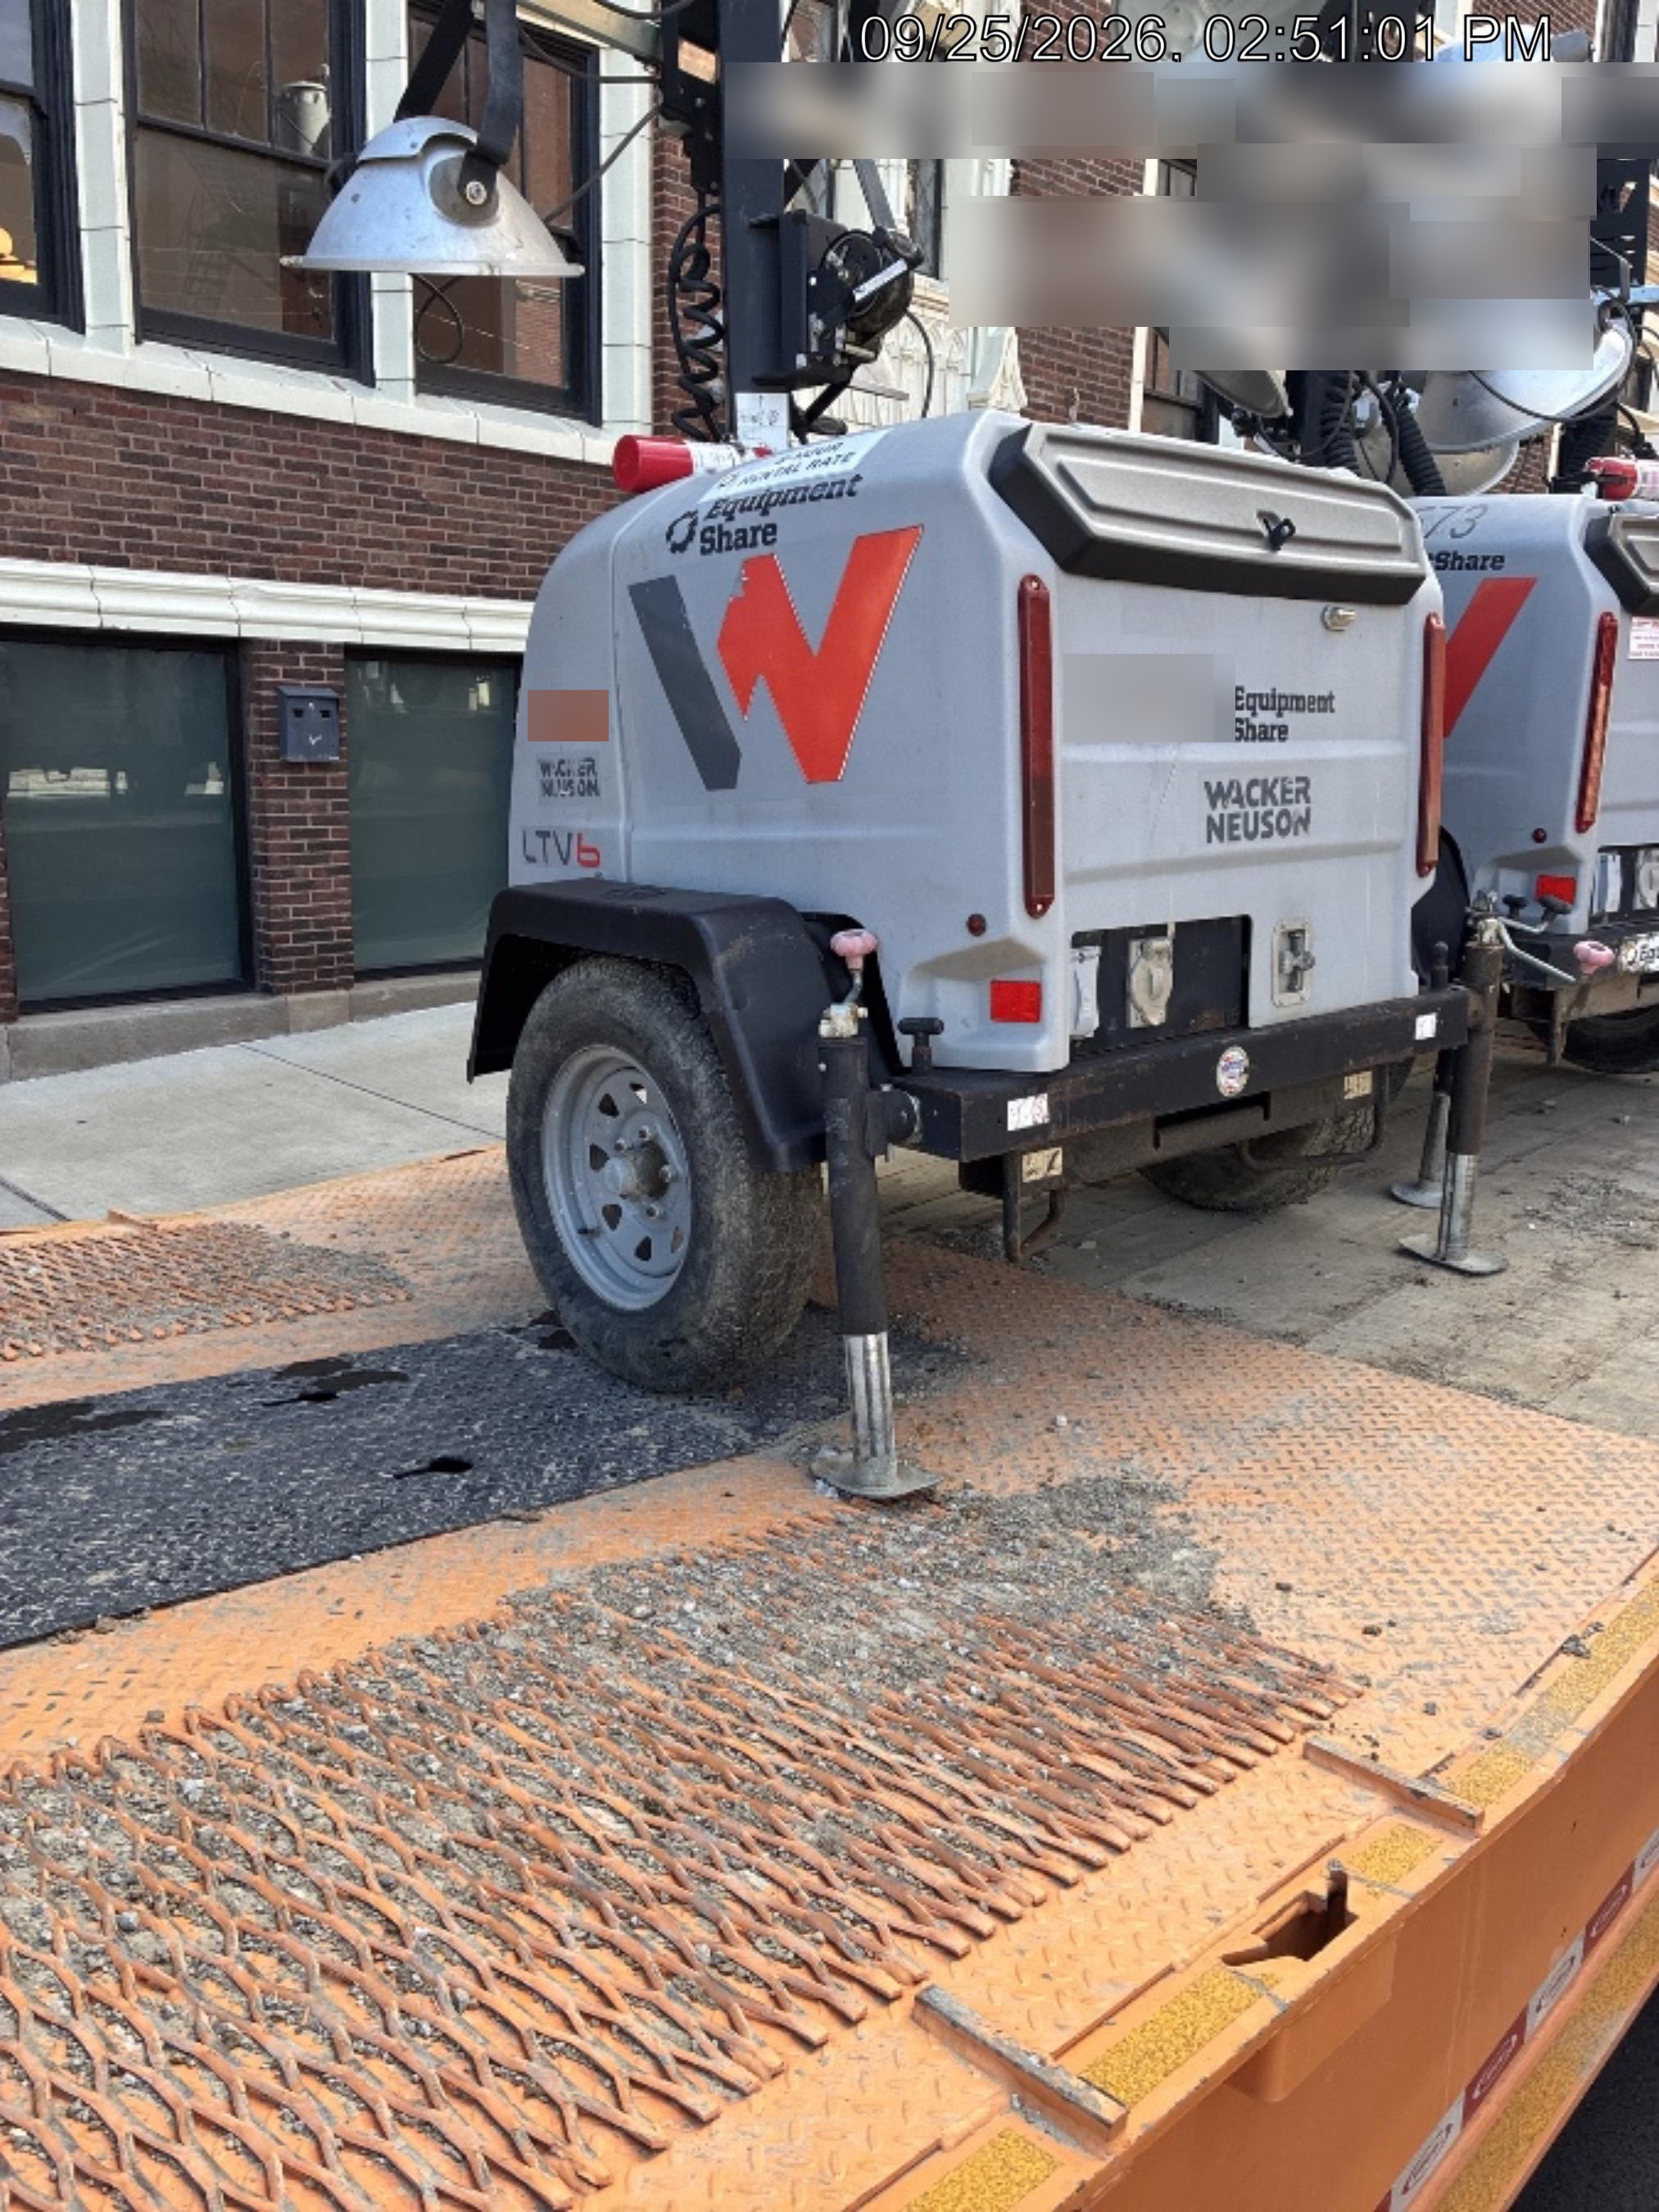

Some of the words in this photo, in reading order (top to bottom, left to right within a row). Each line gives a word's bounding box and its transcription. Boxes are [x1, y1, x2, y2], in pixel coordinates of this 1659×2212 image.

[703, 473, 864, 522] Equipment
[699, 522, 778, 555] Share
[1435, 550, 1506, 571] Share
[1235, 686, 1336, 718] Equipment
[1235, 717, 1289, 742] Share
[1203, 775, 1312, 809] WACKER
[1205, 806, 1312, 845] NEUSON
